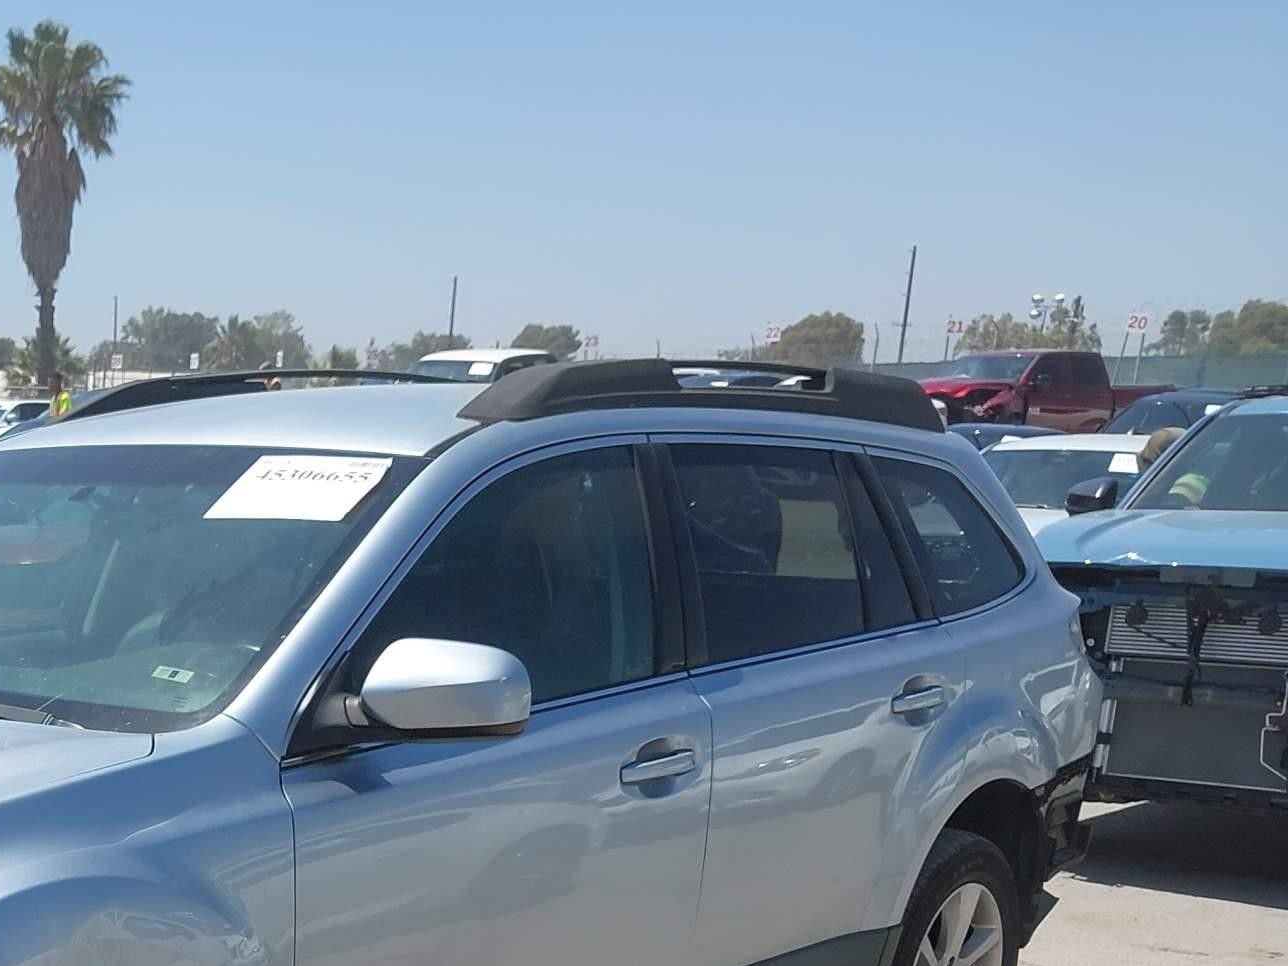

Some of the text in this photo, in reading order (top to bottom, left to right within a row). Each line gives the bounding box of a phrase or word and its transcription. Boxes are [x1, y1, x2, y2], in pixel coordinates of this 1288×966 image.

[946, 319, 963, 334] 21
[1127, 315, 1148, 330] 20
[256, 469, 373, 483] 45306655
